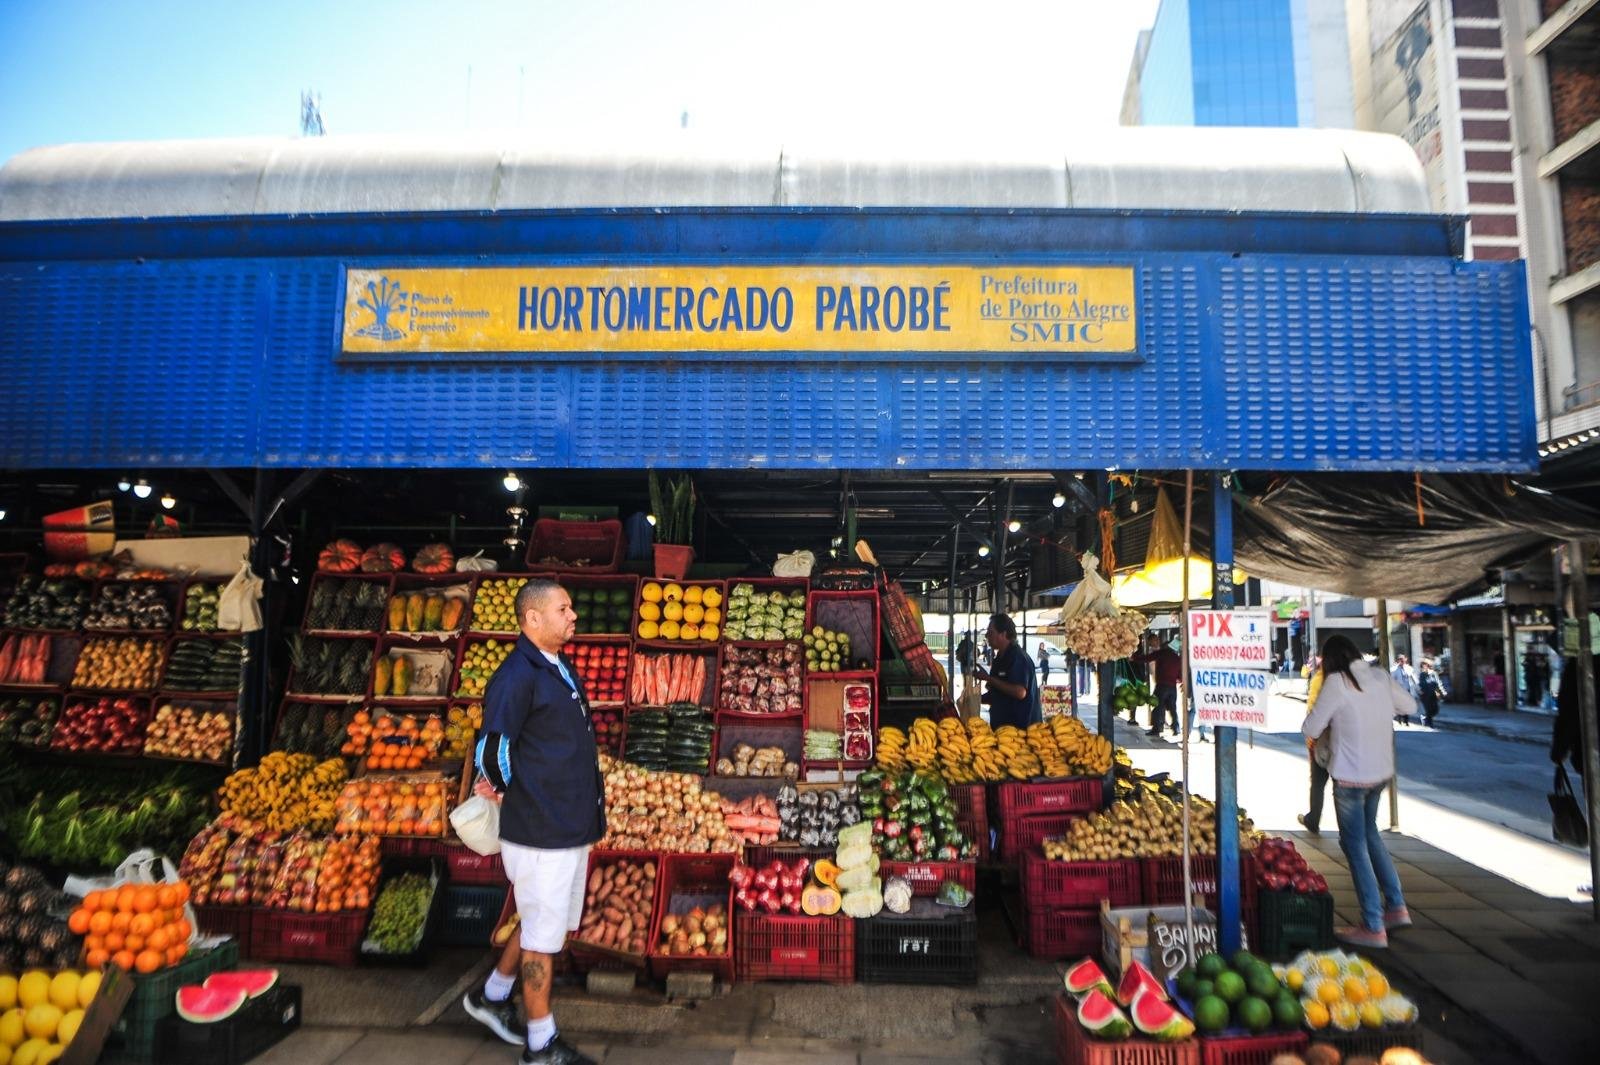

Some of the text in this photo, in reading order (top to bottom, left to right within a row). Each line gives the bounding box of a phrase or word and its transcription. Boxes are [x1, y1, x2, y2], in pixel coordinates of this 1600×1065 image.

[980, 275, 1078, 295] Prefeitura
[411, 292, 454, 305] Plano de
[518, 280, 951, 333] HORTOMERCADO PAROBÉ
[410, 306, 490, 318] Desenvolvimento
[980, 298, 1130, 322] de Porto Alegre
[1010, 322, 1104, 343] SMIC
[1191, 613, 1233, 637] PIX
[1193, 645, 1266, 661] 86009974020
[1195, 670, 1266, 690] ACEITAMOS
[1203, 692, 1256, 707] CARTÕES
[1222, 710, 1229, 721] E
[1230, 710, 1266, 725] CRÉDITO
